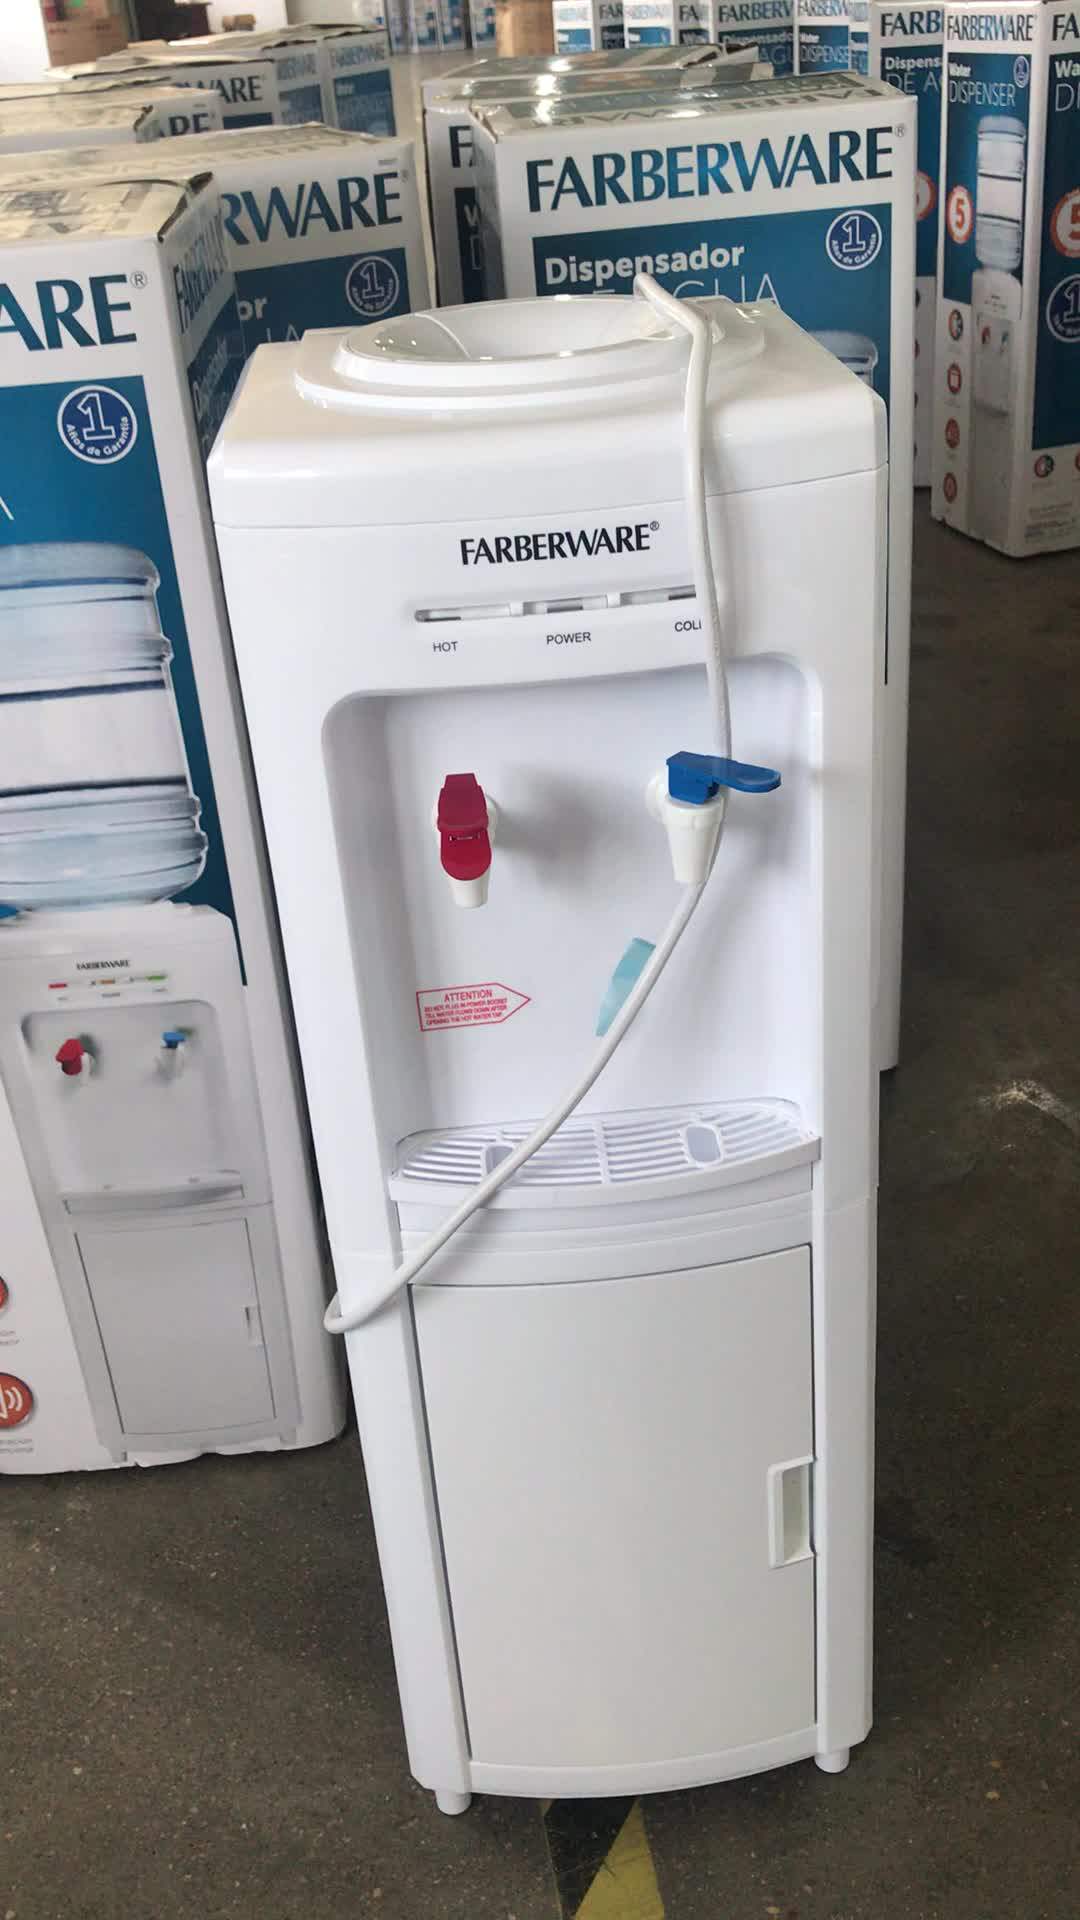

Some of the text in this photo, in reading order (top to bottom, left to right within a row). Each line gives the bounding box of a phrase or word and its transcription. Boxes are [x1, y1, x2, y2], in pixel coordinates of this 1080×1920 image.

[545, 243, 745, 286] Dispensador
[77, 392, 116, 441] 1
[86, 445, 101, 457] de
[546, 631, 591, 645] POWER
[433, 641, 458, 652] HOT
[444, 990, 493, 1002] ATTENTION
